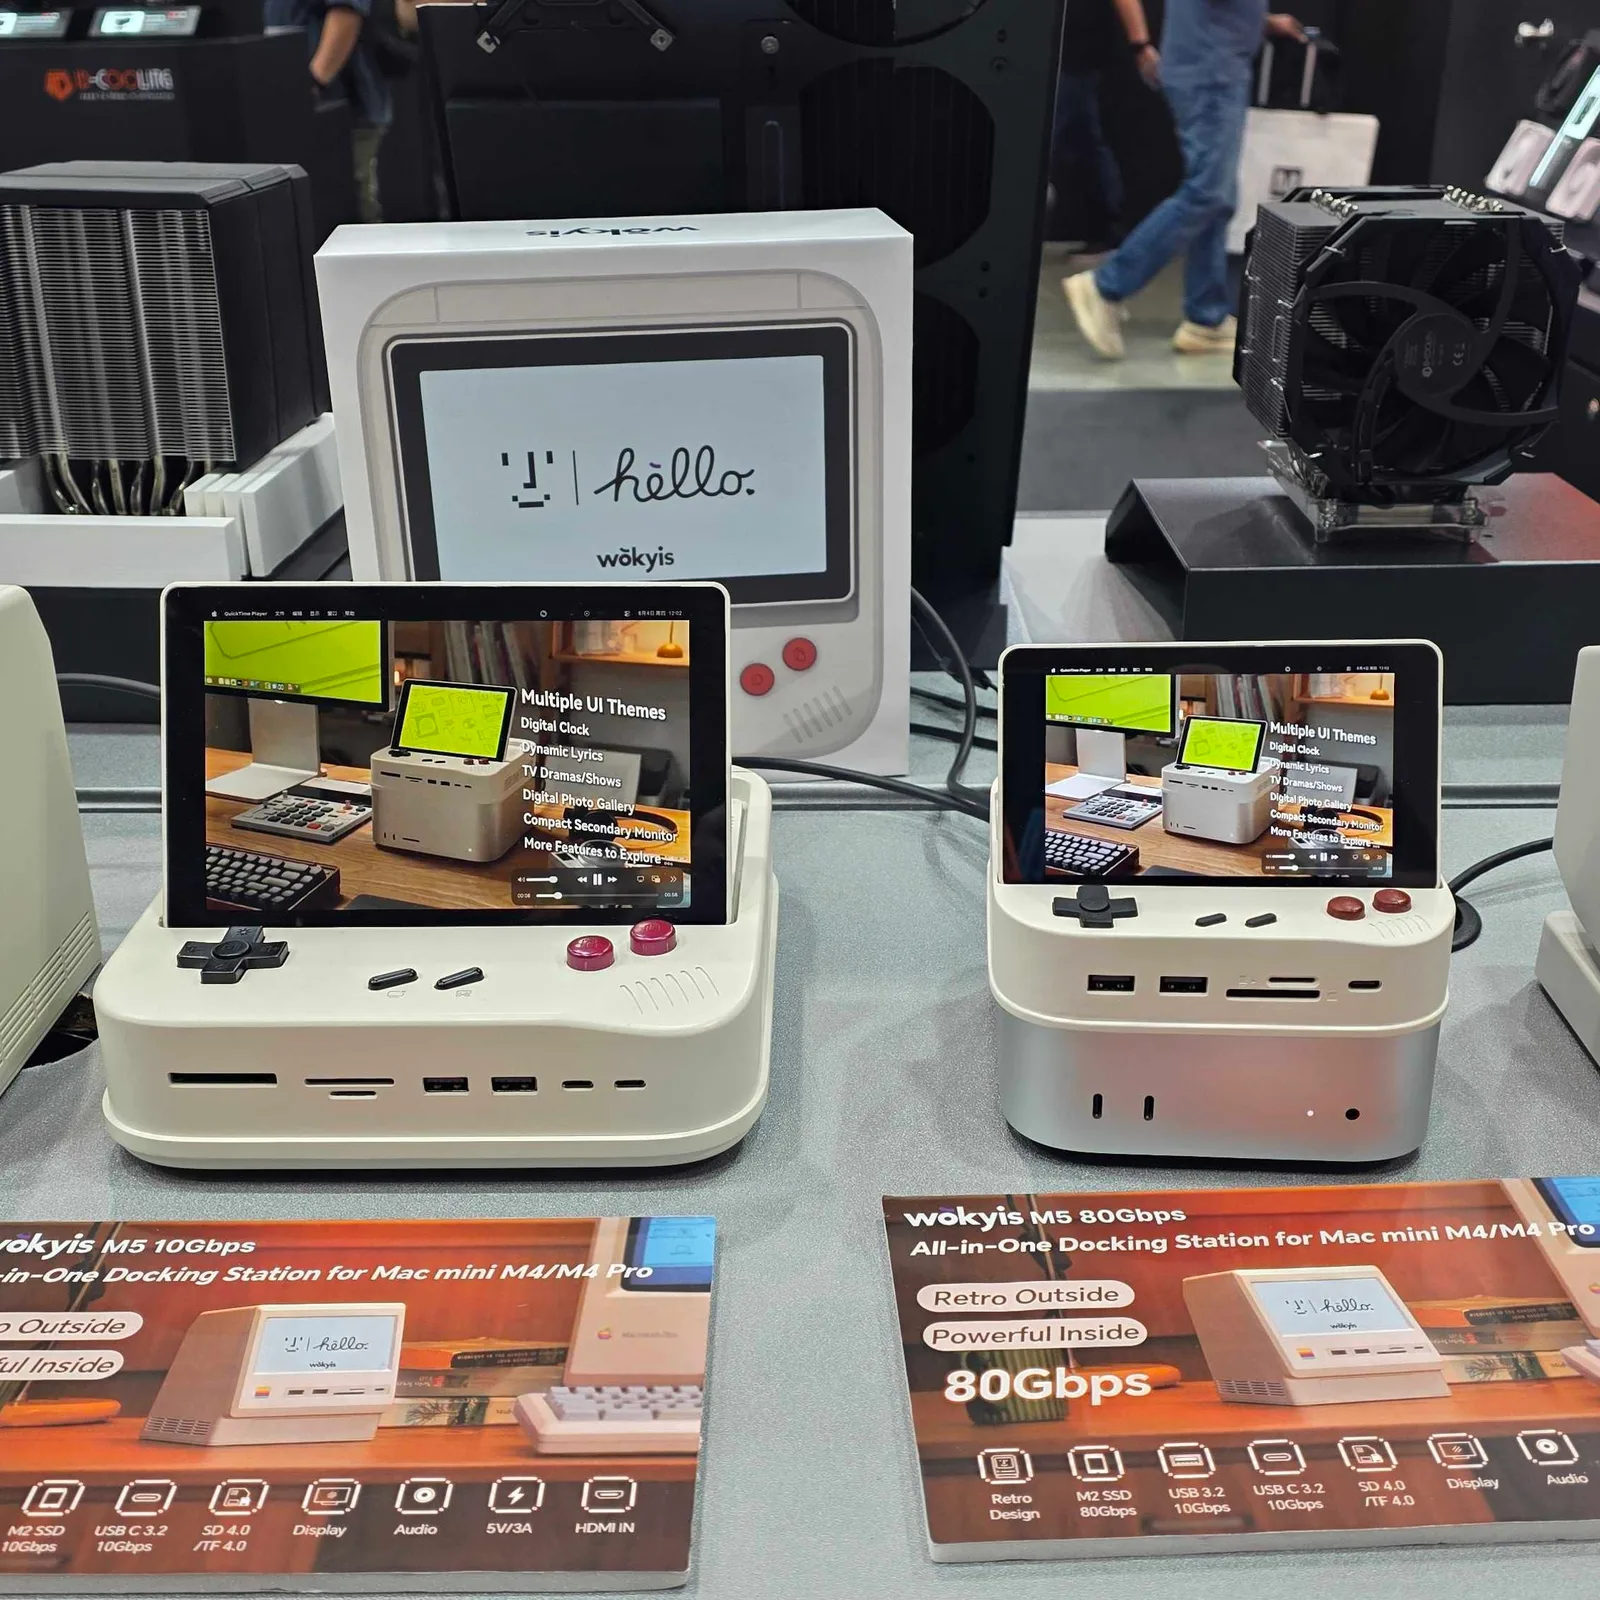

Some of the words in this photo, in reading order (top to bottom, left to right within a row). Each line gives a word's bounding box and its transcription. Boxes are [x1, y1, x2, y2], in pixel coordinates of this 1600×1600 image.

[521, 688, 583, 713] Multiple
[586, 695, 604, 713] UI
[606, 697, 667, 721] Themes
[520, 716, 557, 734] Digital
[559, 721, 590, 737] Clock
[1270, 721, 1316, 739] Multiple
[1317, 727, 1330, 740] UI
[1332, 728, 1377, 745] Themes
[521, 741, 569, 758] Dynamic
[570, 746, 604, 763] Lyrics
[1269, 741, 1296, 753] Digital
[1297, 745, 1320, 756] Clock
[1269, 759, 1304, 771] Dynamic
[1305, 763, 1330, 775] Lyrics
[522, 764, 538, 778] TV
[540, 767, 622, 788] Dramas/Shows
[1269, 775, 1281, 785] TV
[1282, 777, 1343, 793] Dramas/Shows
[522, 788, 559, 806] Digital
[561, 793, 594, 808] Photo
[596, 796, 635, 816] Gallery
[1270, 792, 1297, 804] Digital
[1298, 795, 1322, 807] Photo
[1323, 799, 1353, 812] Gallery
[523, 812, 573, 831] Compact
[574, 819, 632, 839] Secondary
[634, 827, 678, 843] Monitor
[1270, 809, 1306, 822] Compact
[1307, 814, 1350, 829] Secondary
[1351, 819, 1384, 832] Monitor
[1270, 825, 1291, 837] More
[1292, 829, 1328, 842] Features
[1329, 834, 1339, 844] to
[1340, 835, 1372, 848] Explore
[524, 836, 553, 852] More
[555, 840, 603, 857] Features
[604, 847, 617, 860] to
[619, 849, 662, 865] Explore
[1030, 1210, 1073, 1226] M5
[1080, 1208, 1187, 1227] 80Gbps
[909, 1238, 1053, 1256] All-in-One
[1058, 1235, 1168, 1254] Docking
[1175, 1232, 1270, 1249] Station
[1275, 1231, 1313, 1246] for
[1320, 1229, 1379, 1245] Mac
[1382, 1226, 1439, 1243] mini
[1445, 1222, 1542, 1241] M4/M4
[1547, 1221, 1596, 1237] Pro
[100, 1239, 148, 1254] M5
[154, 1237, 257, 1256] 10Gbps
[102, 1266, 219, 1285] Docking
[222, 1265, 324, 1282] Station
[327, 1265, 367, 1282] for
[371, 1265, 431, 1281] Mac
[434, 1264, 498, 1280] mini
[500, 1263, 599, 1280] M4/M4
[605, 1263, 654, 1279] Pro
[933, 1290, 1008, 1307] Retro
[1015, 1287, 1120, 1305] Outside
[18, 1318, 127, 1335] Outside
[931, 1325, 1052, 1345] Powerful
[1060, 1324, 1140, 1342] Inside
[28, 1357, 115, 1374] Inside
[944, 1366, 1152, 1406] 80Gbps
[1357, 1480, 1380, 1492] SD
[1381, 1479, 1406, 1491] 4.0
[1446, 1477, 1500, 1490] Display
[1546, 1472, 1588, 1485] Audio
[1076, 1491, 1100, 1502] M2
[1102, 1490, 1132, 1501] SSD
[1168, 1487, 1199, 1499] USB
[1201, 1486, 1226, 1498] 3.2
[1252, 1484, 1285, 1496] USB
[1286, 1484, 1300, 1495] C
[1301, 1483, 1326, 1494] 3.2
[991, 1493, 1033, 1505] Retro
[1267, 1498, 1324, 1512] 10Gbps
[1365, 1495, 1389, 1507] /TF
[1390, 1494, 1415, 1506] 4.0
[989, 1508, 1041, 1521] Design
[1079, 1504, 1137, 1518] 80Gbps
[1174, 1502, 1231, 1515] 10Gbps
[7, 1525, 33, 1537] M2
[33, 1525, 66, 1537] SSD
[94, 1525, 127, 1537] USB
[128, 1525, 142, 1537] C
[142, 1525, 169, 1537] 3.2
[201, 1524, 225, 1536] SD
[226, 1524, 251, 1536] 4.0
[292, 1524, 348, 1538] Display
[393, 1523, 438, 1536] Audio
[486, 1522, 533, 1535] 5V/3A
[575, 1522, 617, 1534] HDMI
[618, 1522, 635, 1534] IN
[1, 1540, 58, 1554] 10Gbps
[96, 1540, 153, 1554] 10Gbps
[192, 1540, 222, 1551] /TF
[222, 1540, 248, 1551] 4.0
